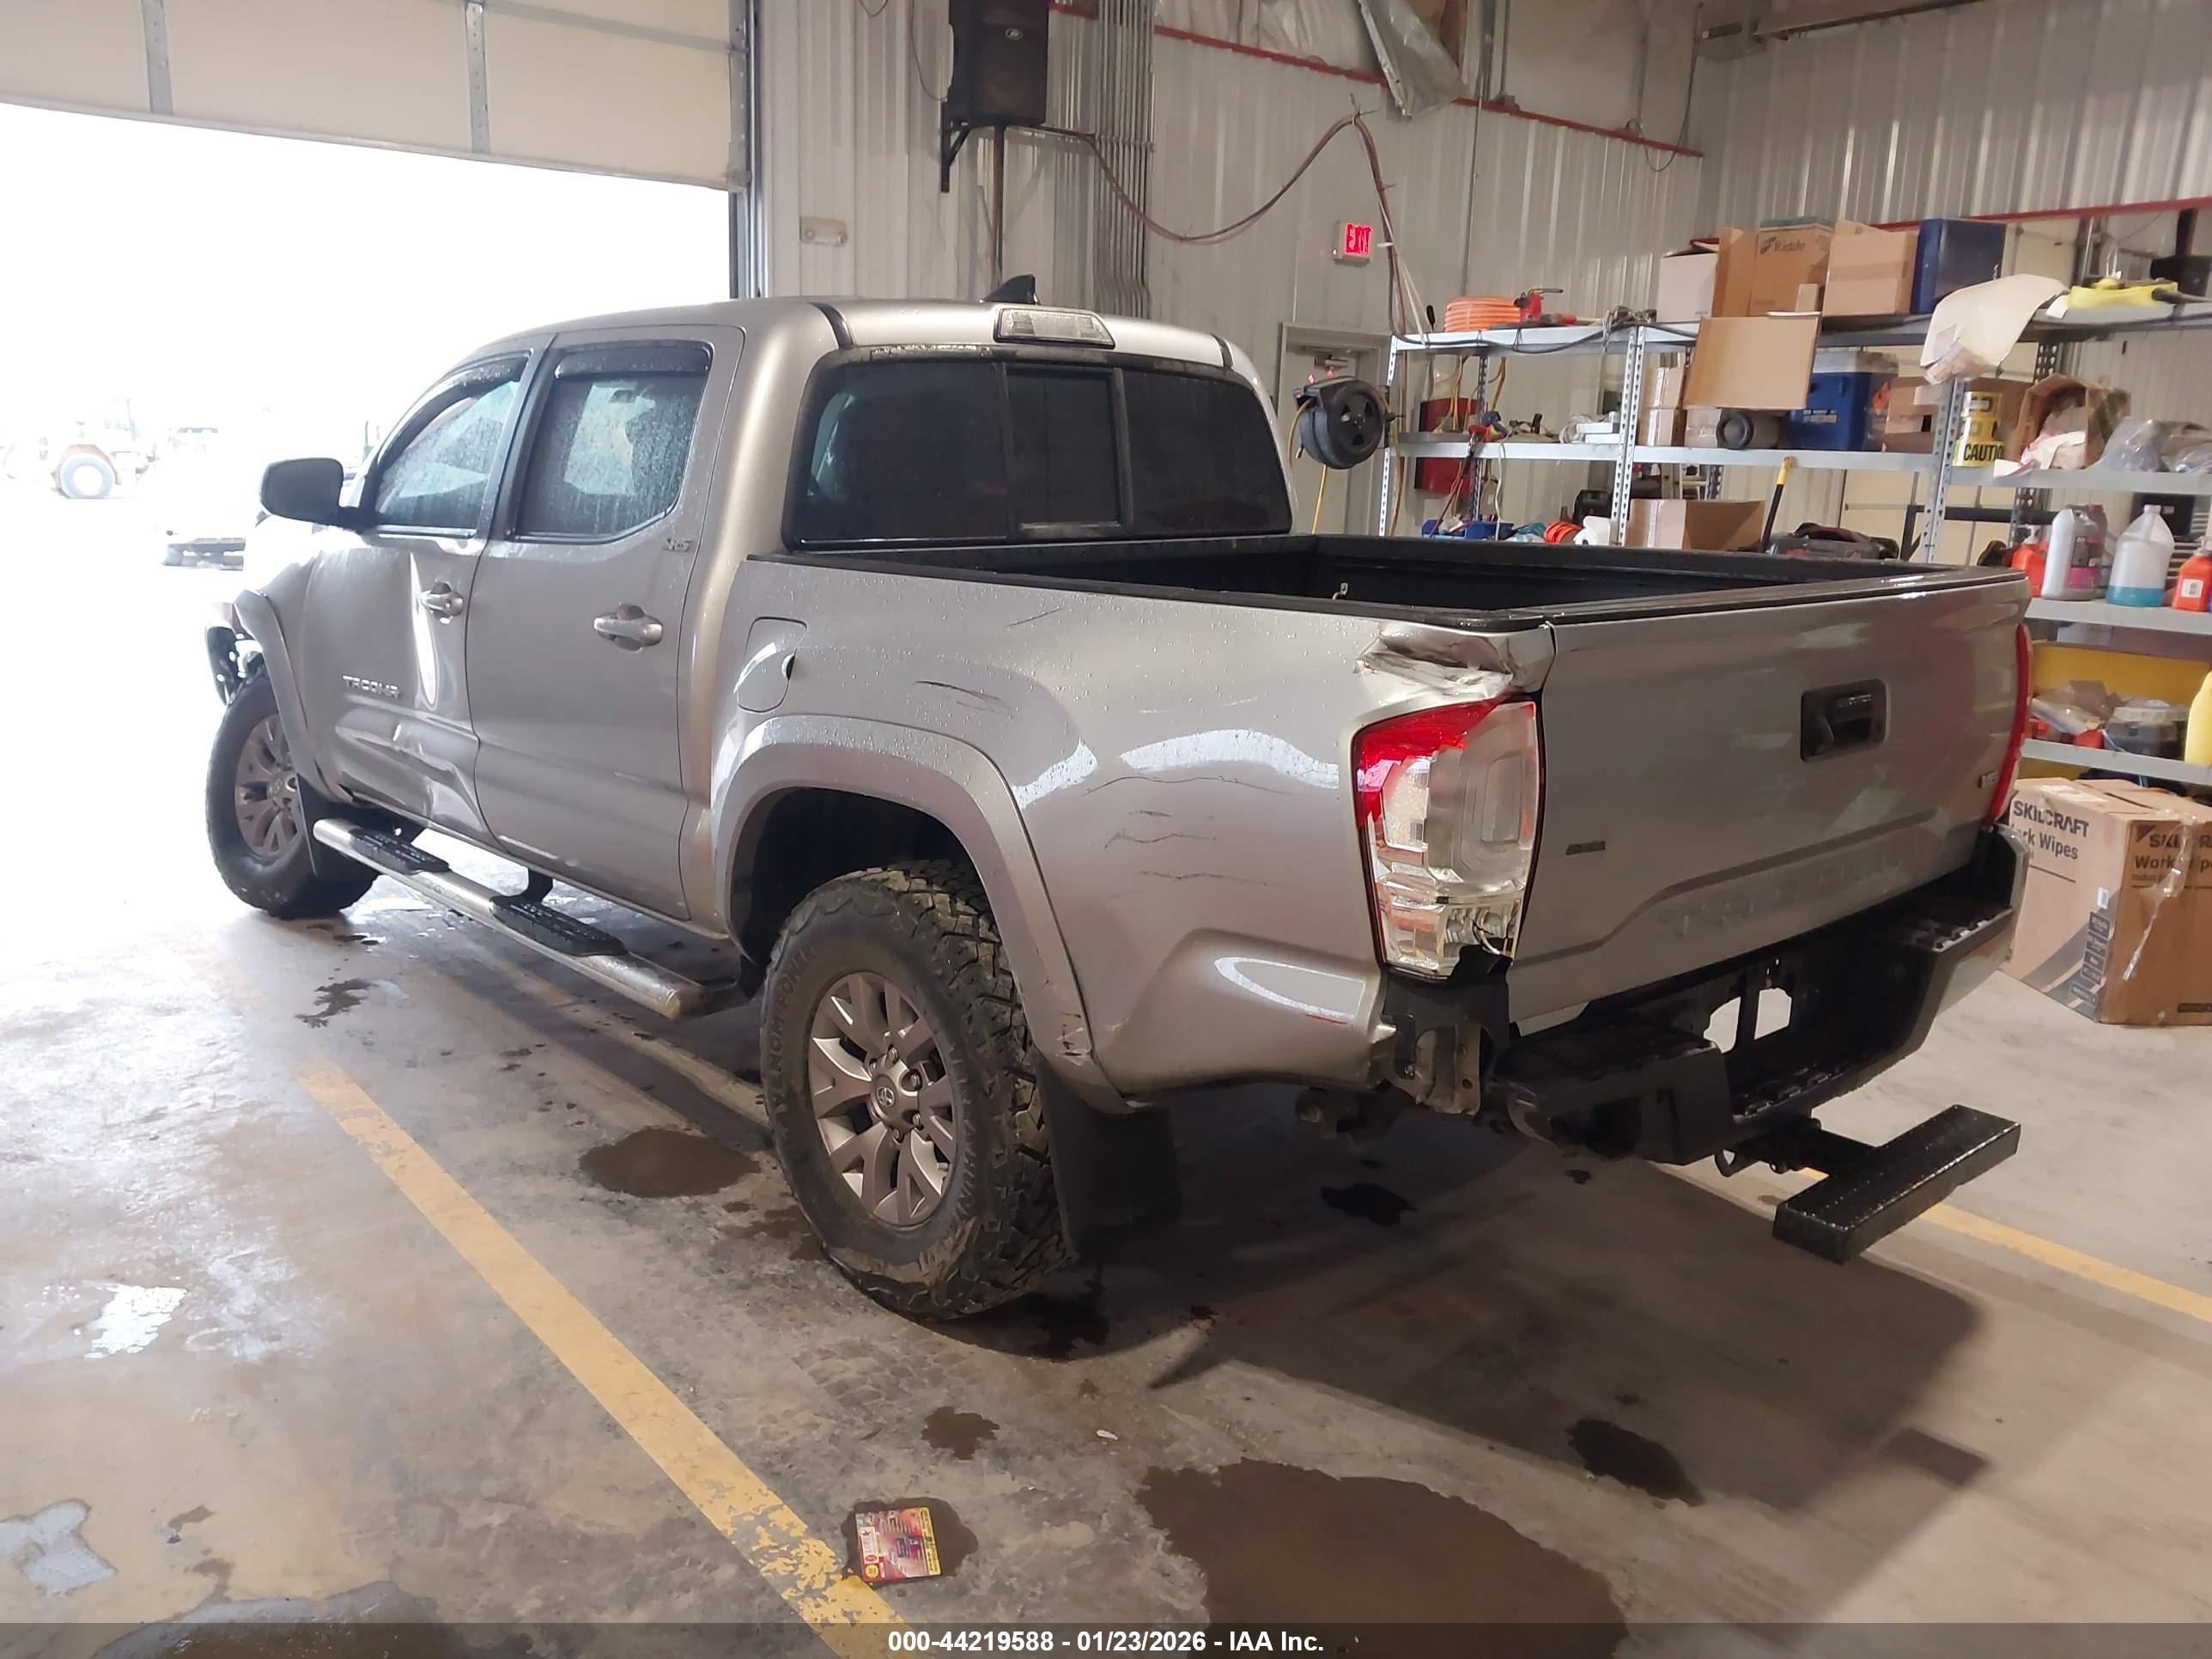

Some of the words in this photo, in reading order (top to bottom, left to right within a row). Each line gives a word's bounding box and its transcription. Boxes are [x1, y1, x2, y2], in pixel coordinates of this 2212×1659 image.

[1346, 223, 1371, 255] EXIT
[2014, 800, 2089, 837] SKILCRAFT
[2039, 832, 2078, 860] Wipes
